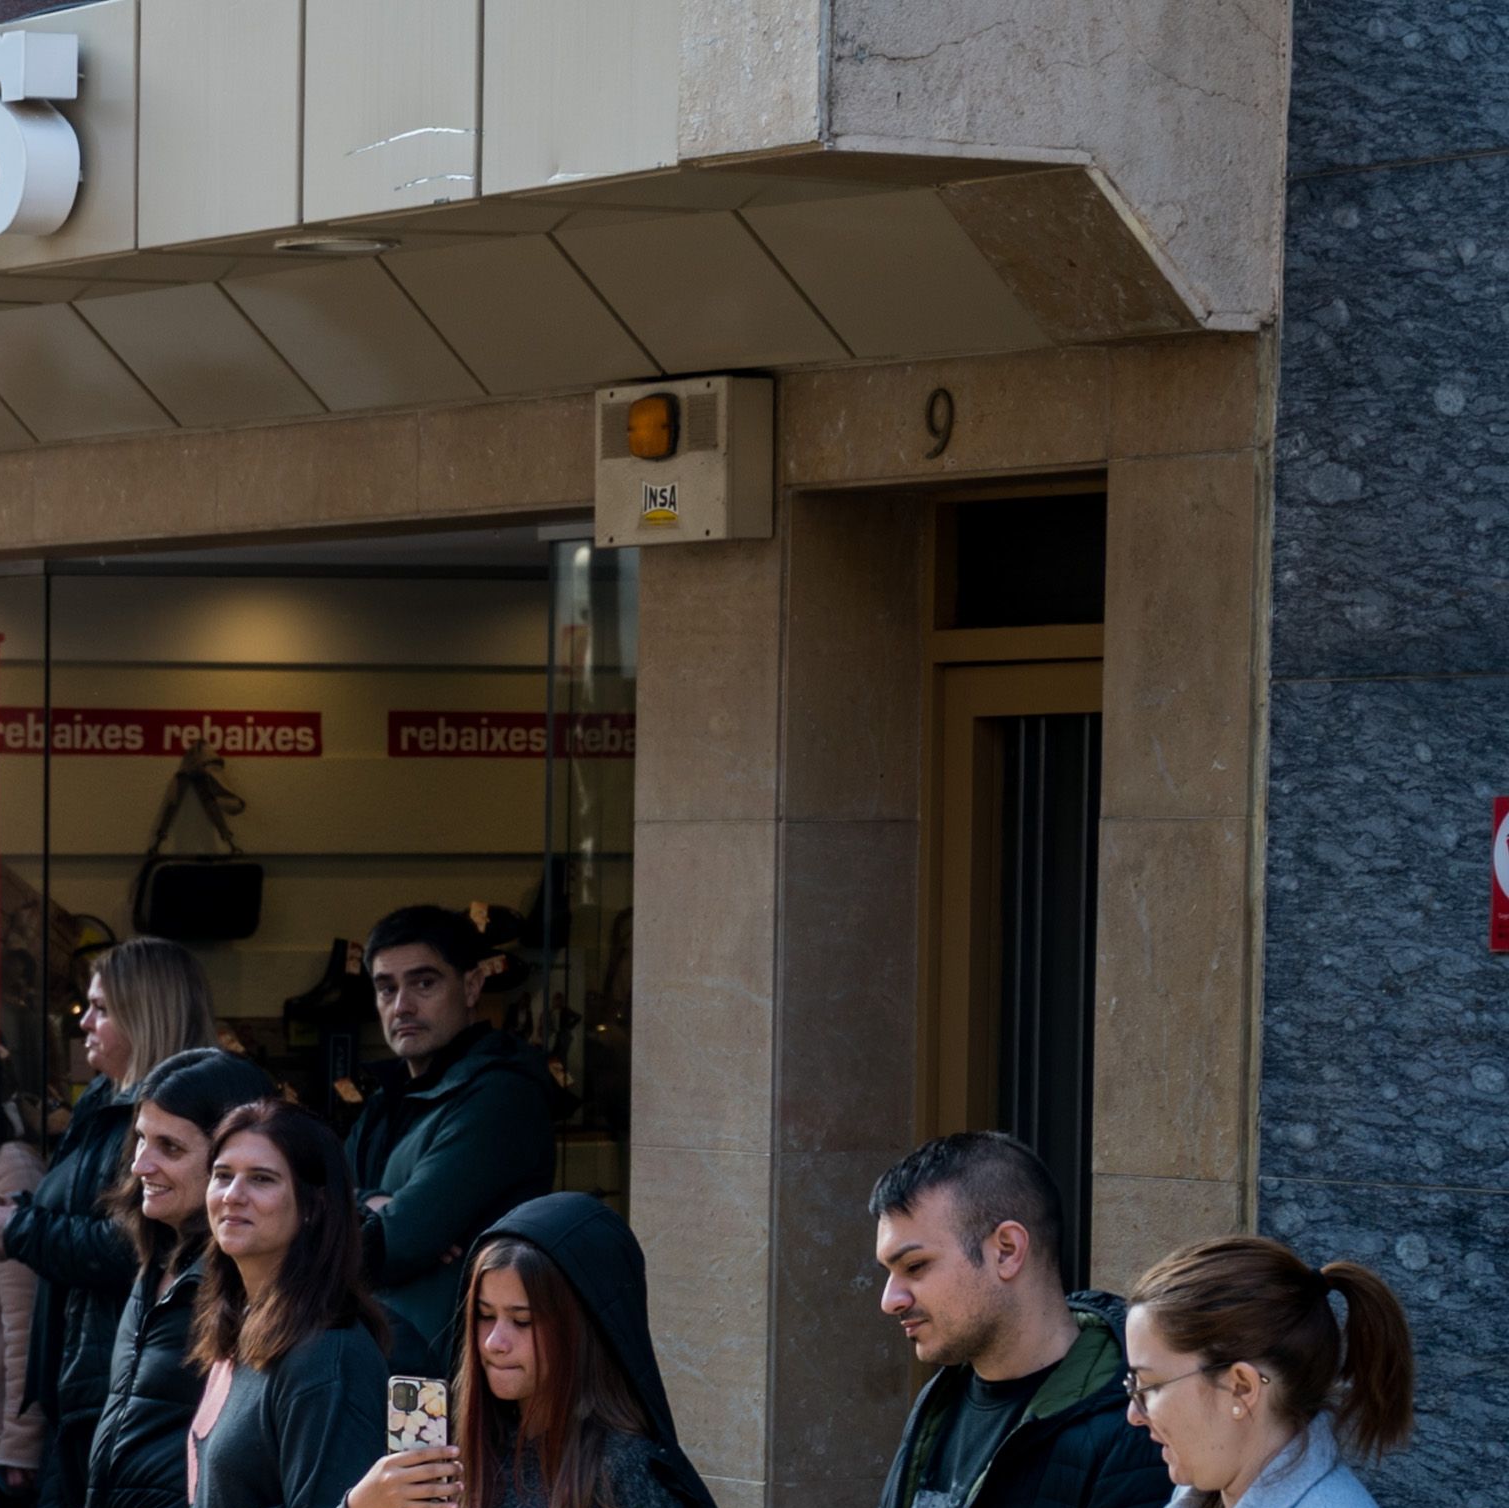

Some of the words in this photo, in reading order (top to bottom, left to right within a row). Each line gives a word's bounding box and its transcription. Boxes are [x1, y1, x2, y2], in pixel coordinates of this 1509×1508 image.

[925, 387, 955, 460] 9
[643, 484, 677, 512] INSA
[163, 715, 316, 752] rebaixes
[399, 717, 548, 752] rebaixes
